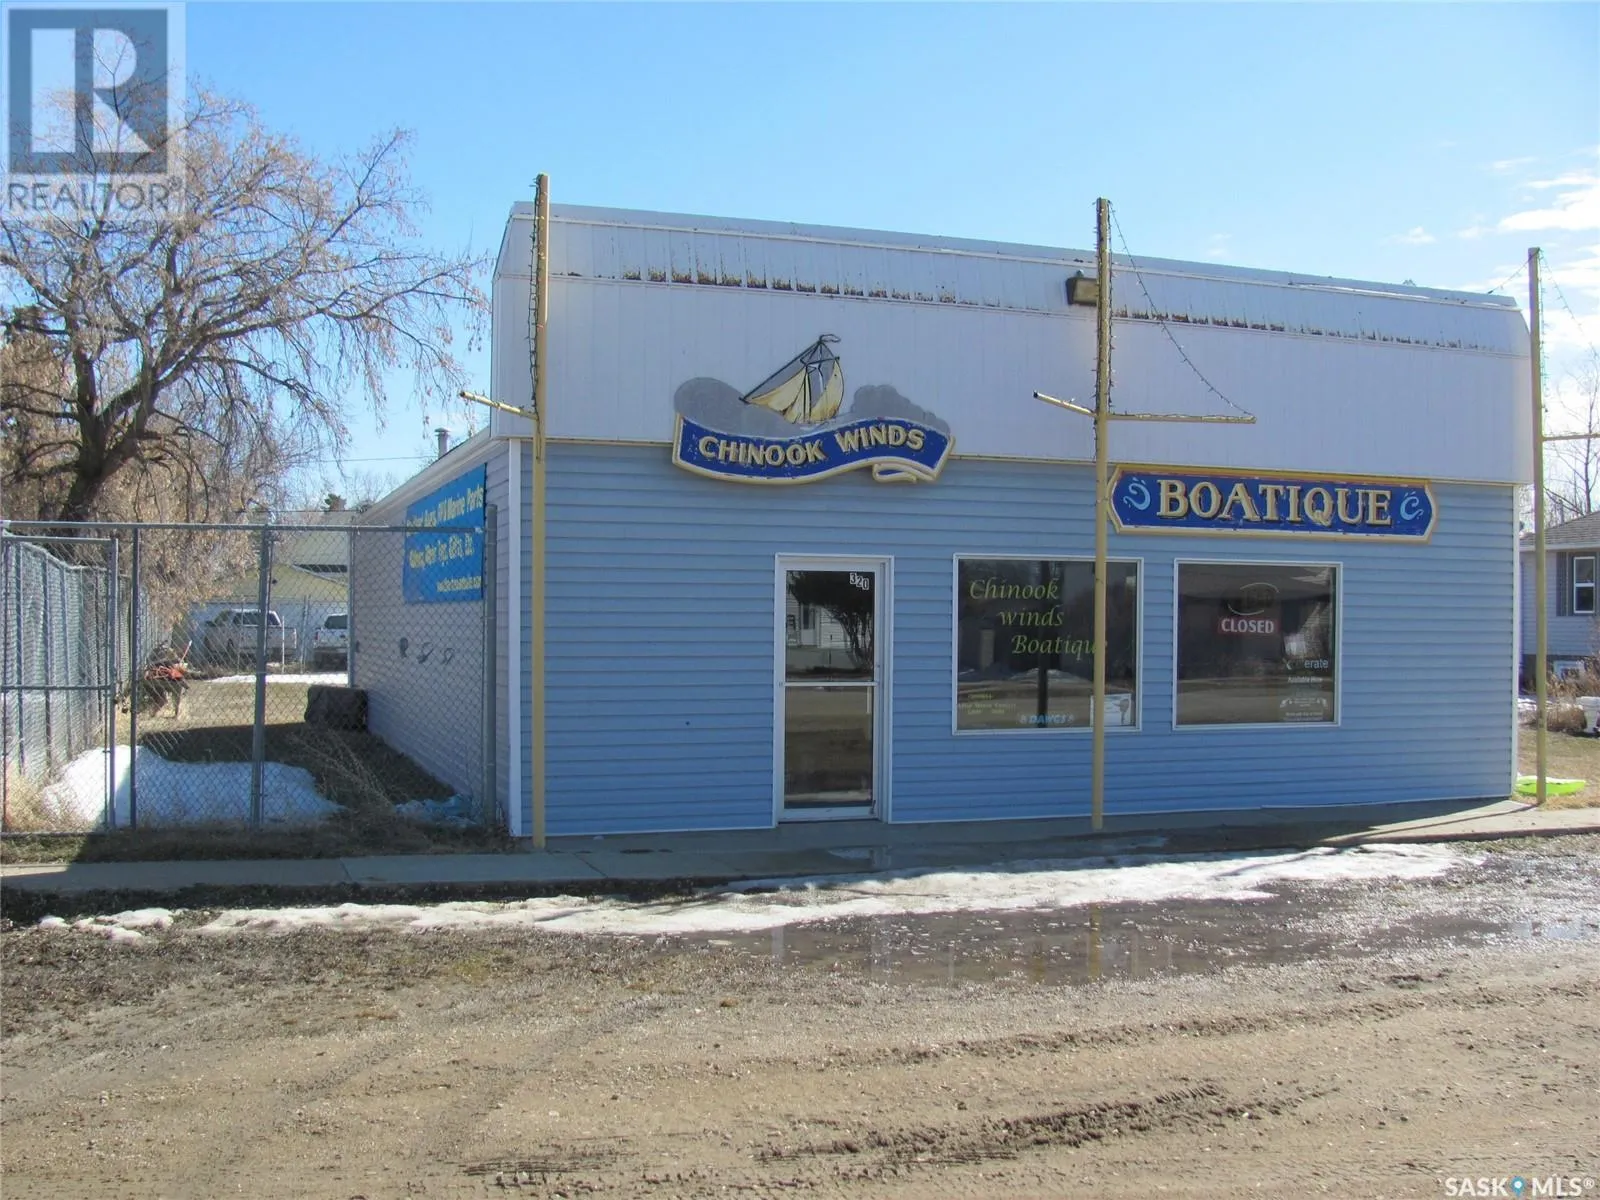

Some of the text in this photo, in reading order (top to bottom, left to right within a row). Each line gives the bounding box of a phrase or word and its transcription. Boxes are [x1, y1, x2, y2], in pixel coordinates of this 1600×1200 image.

[698, 424, 926, 467] CHINOOK WINDS
[1156, 479, 1392, 528] BOATIQUE
[849, 572, 870, 591] 320
[969, 577, 1060, 600] Chinook
[998, 605, 1065, 627] winds
[1220, 618, 1274, 634] CLOSED
[1011, 635, 1107, 660] Boatiqu
